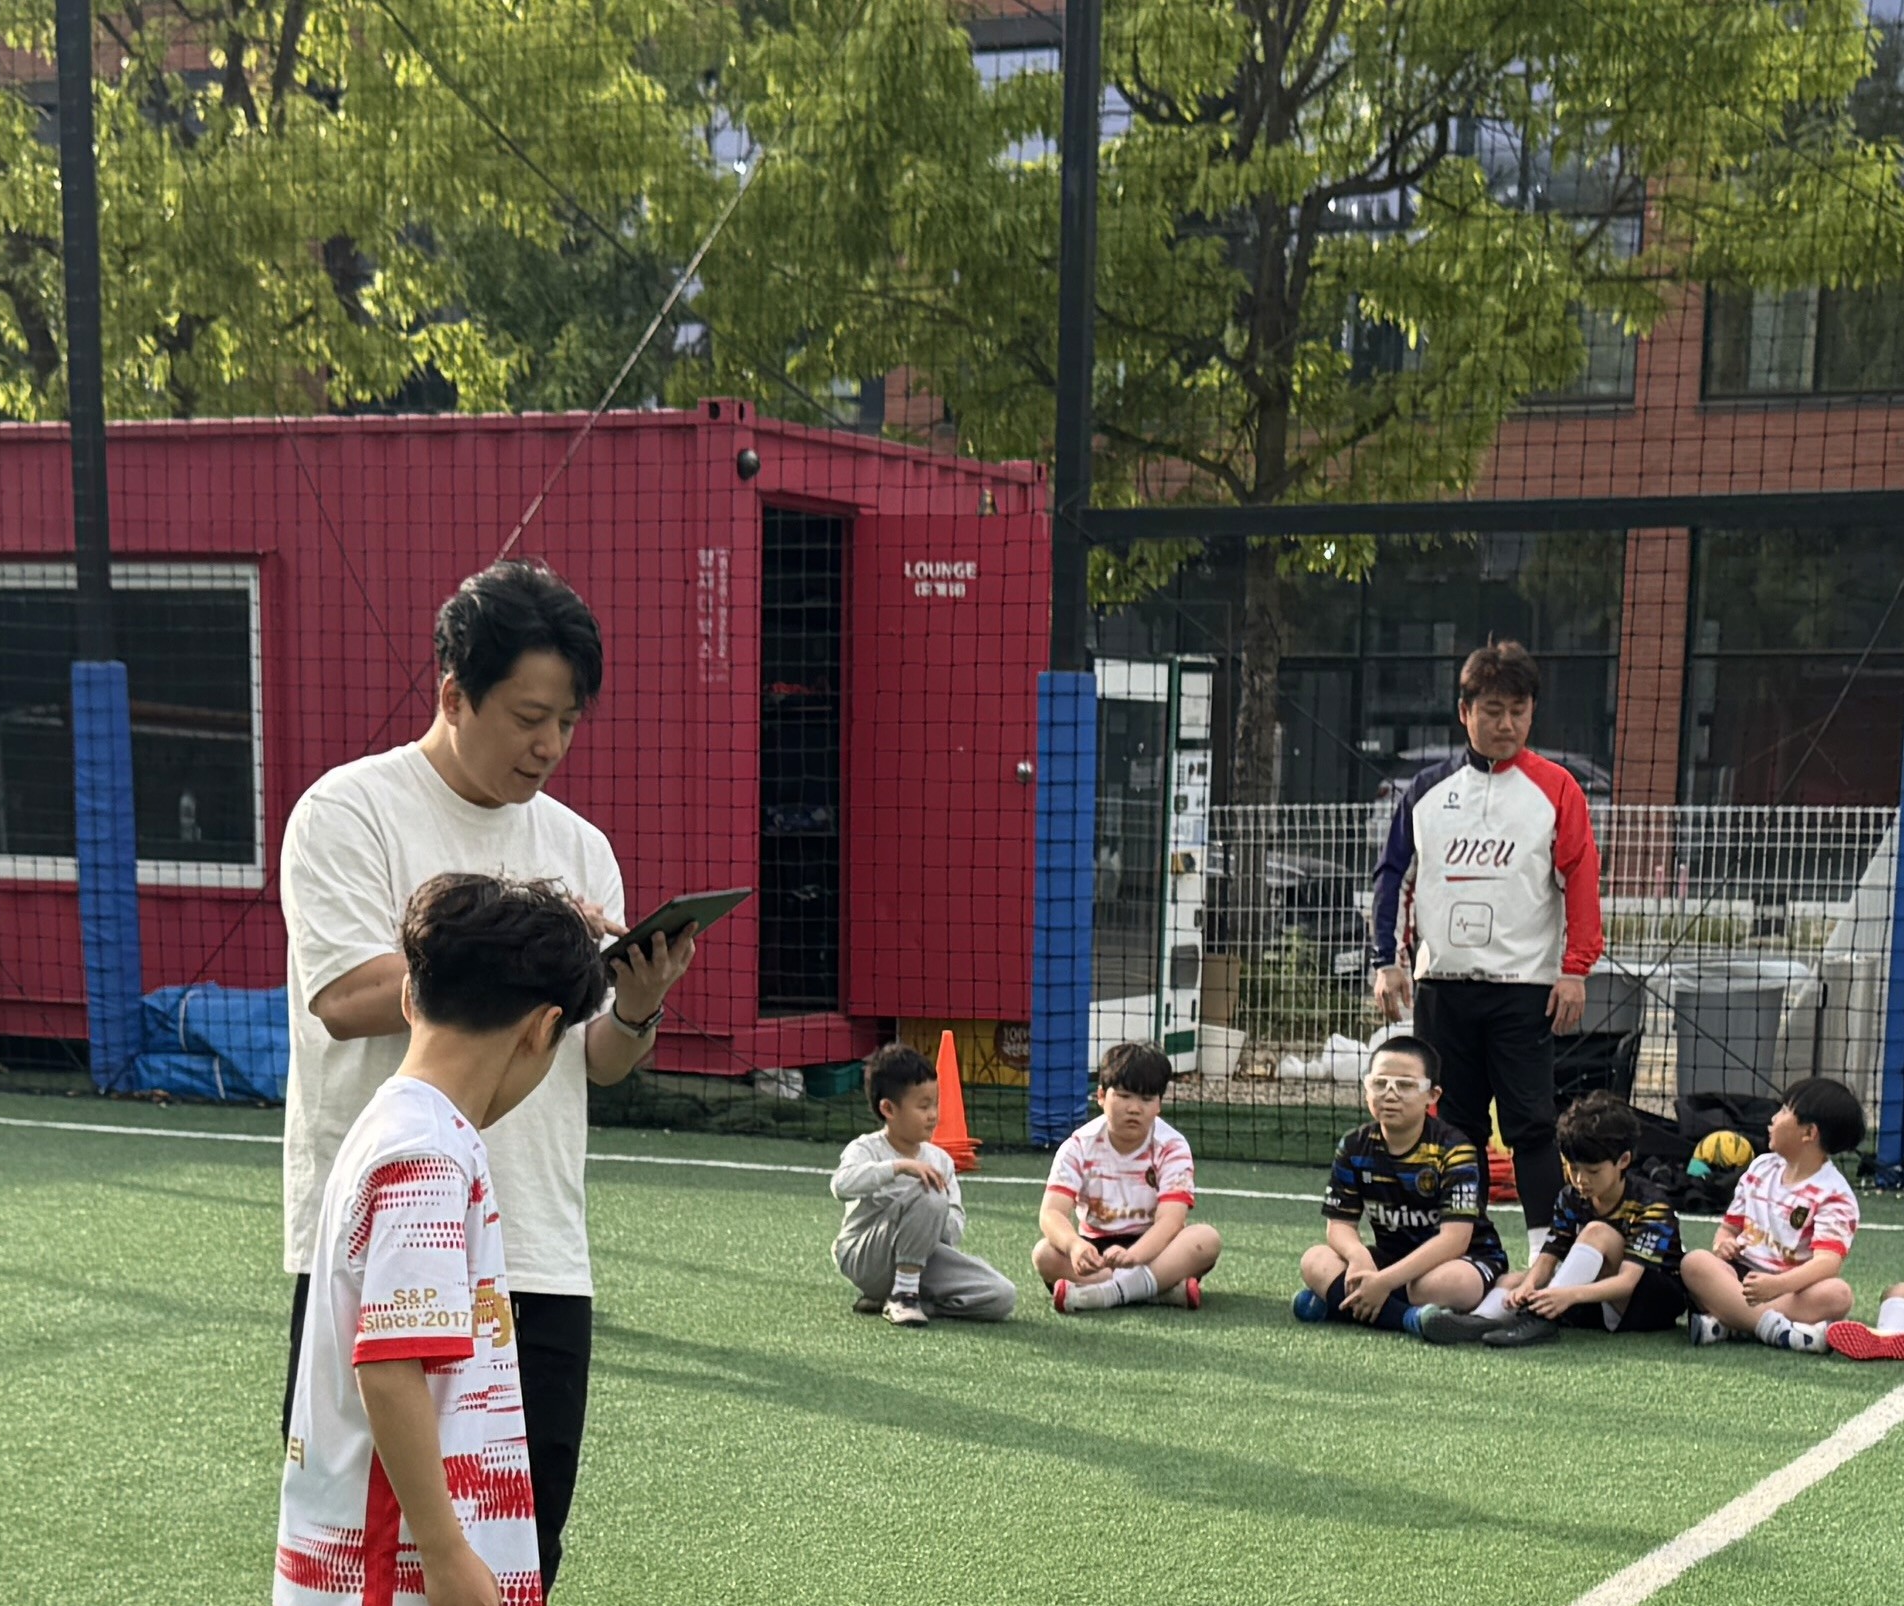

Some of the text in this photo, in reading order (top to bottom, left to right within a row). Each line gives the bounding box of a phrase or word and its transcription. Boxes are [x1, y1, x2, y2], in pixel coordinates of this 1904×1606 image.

[904, 560, 977, 580] LOUNGE
[1444, 838, 1516, 868] DIEU
[393, 1287, 438, 1304] S&P
[365, 1310, 469, 1331] Since 2017
